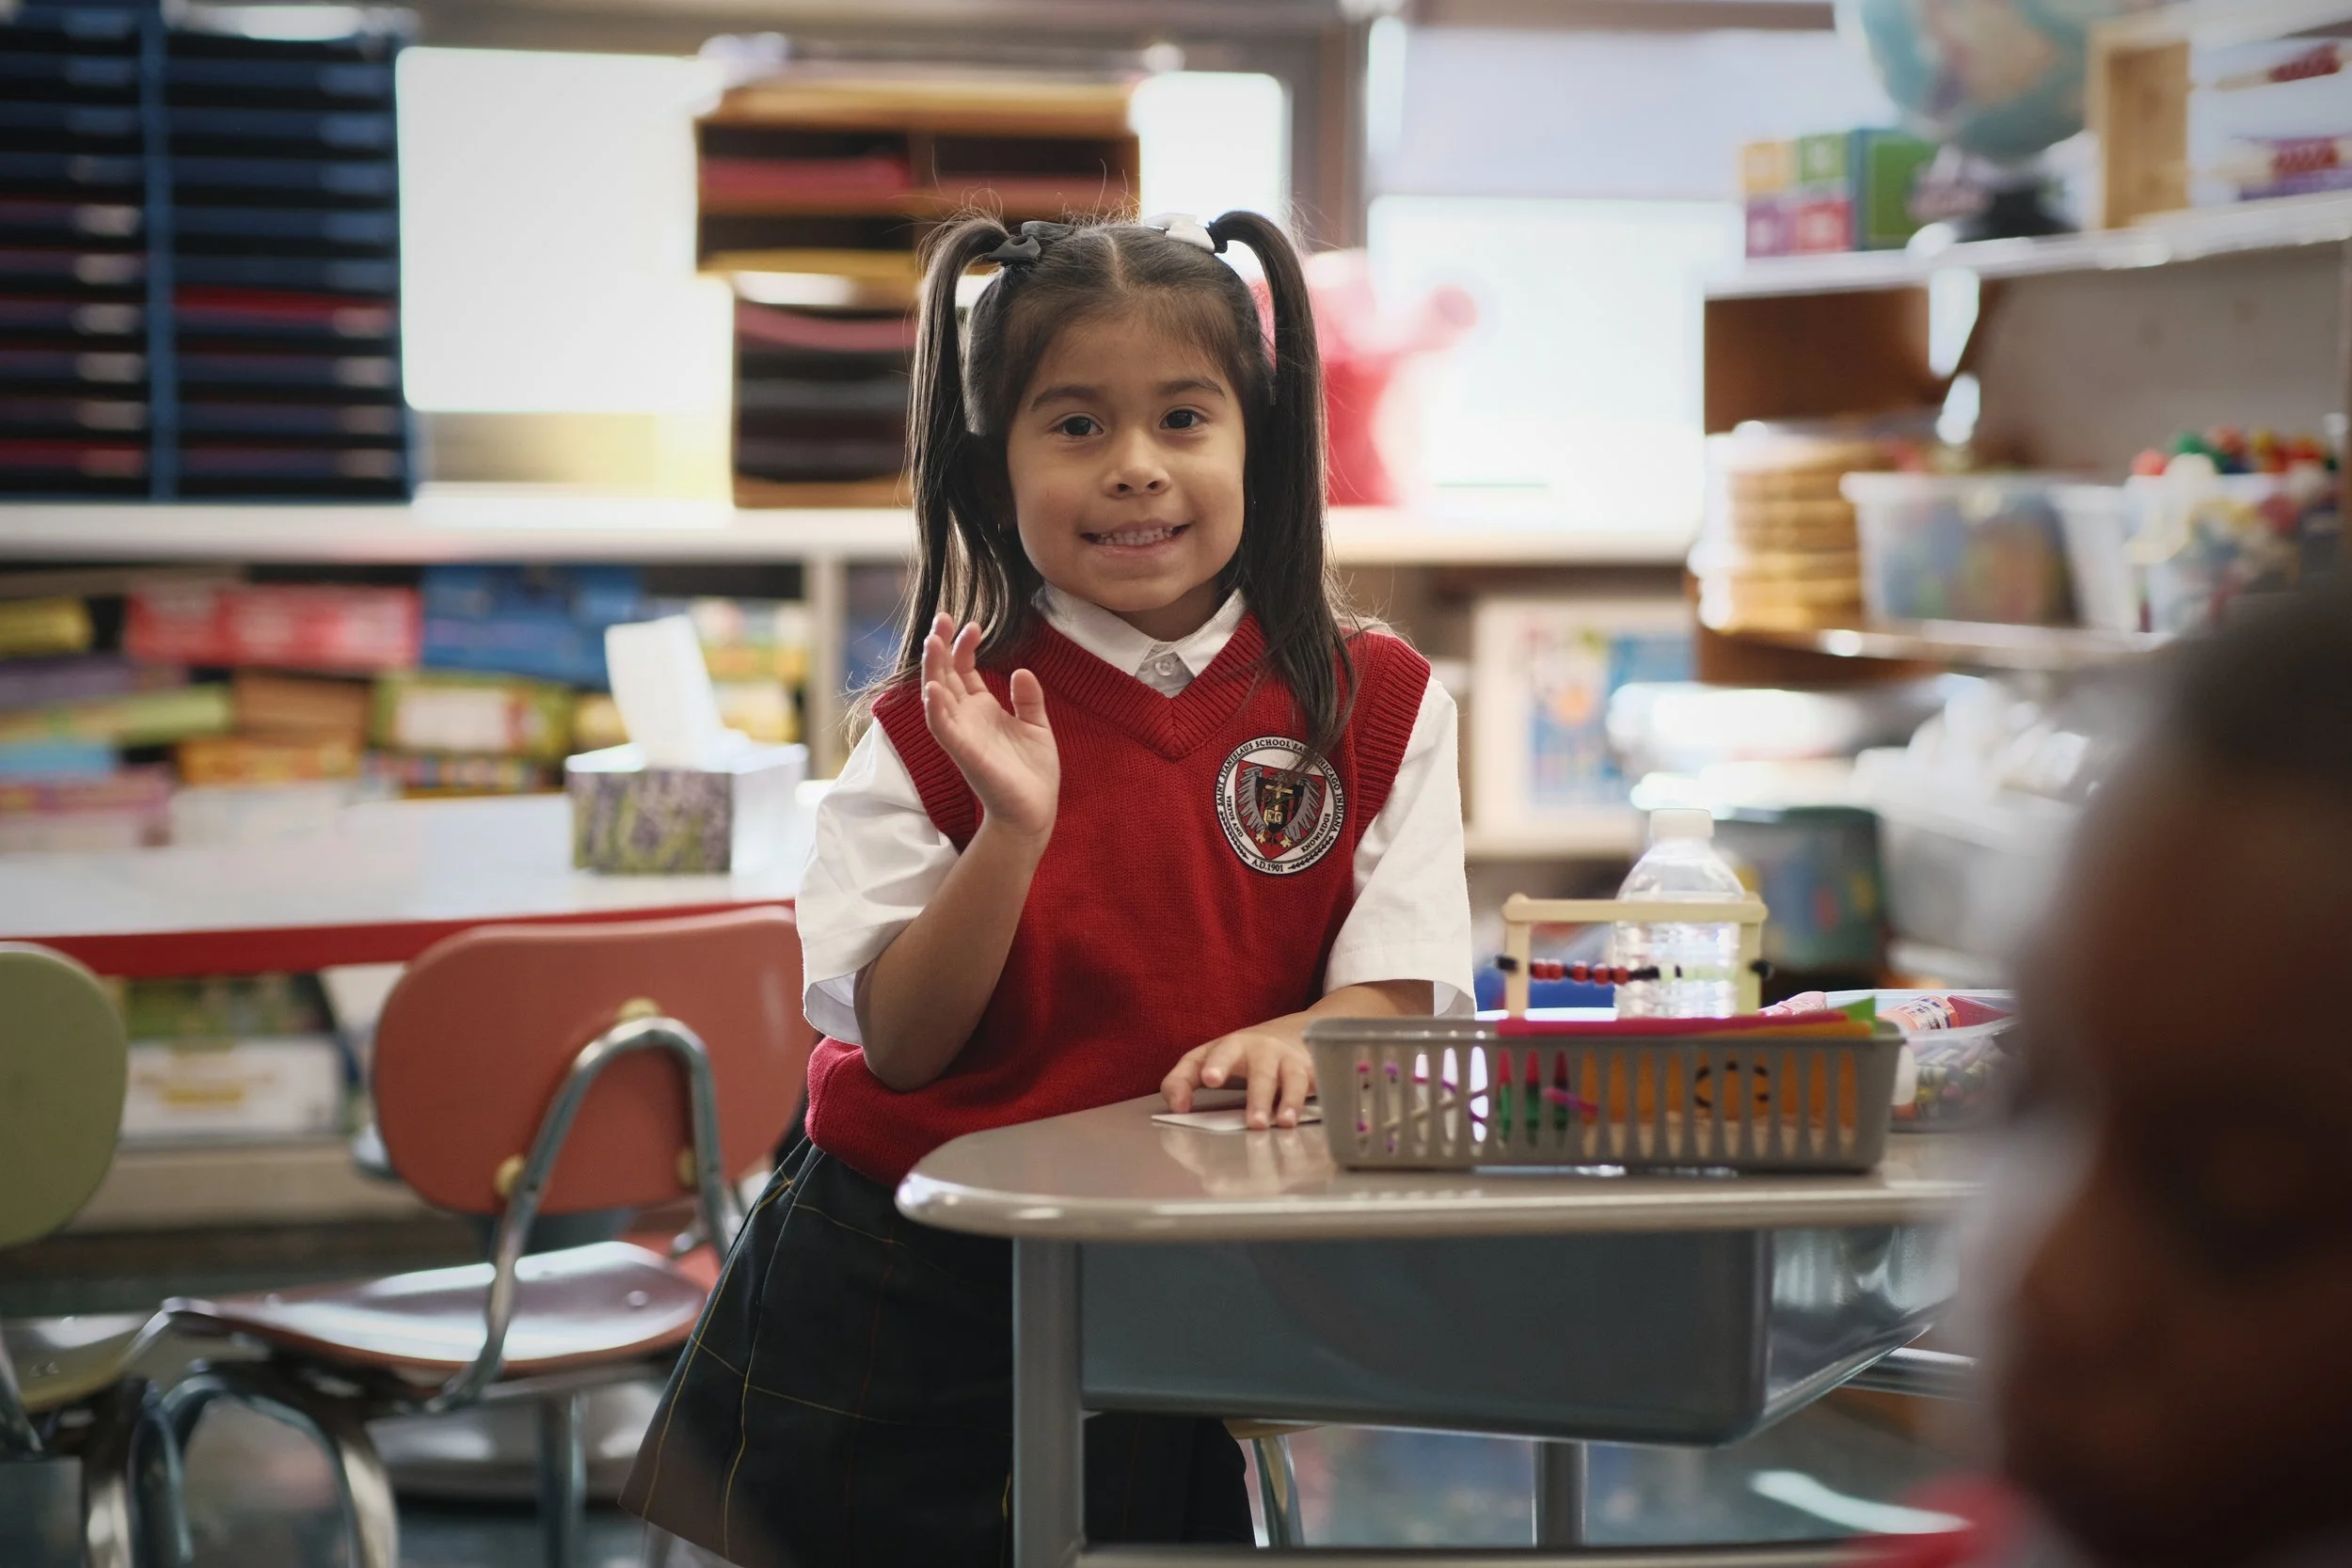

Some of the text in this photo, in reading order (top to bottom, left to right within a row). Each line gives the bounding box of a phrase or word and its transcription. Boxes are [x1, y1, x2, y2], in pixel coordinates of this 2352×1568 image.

[1221, 742, 1254, 779] STANISLAUS
[1255, 738, 1292, 748] SCHOOL
[1317, 758, 1341, 790] HICAGO
[1331, 793, 1343, 832] INDIANA
[1226, 795, 1235, 821] VIRTUE
[1232, 822, 1244, 837] AND
[1300, 813, 1331, 853] KNOWLEDGE
